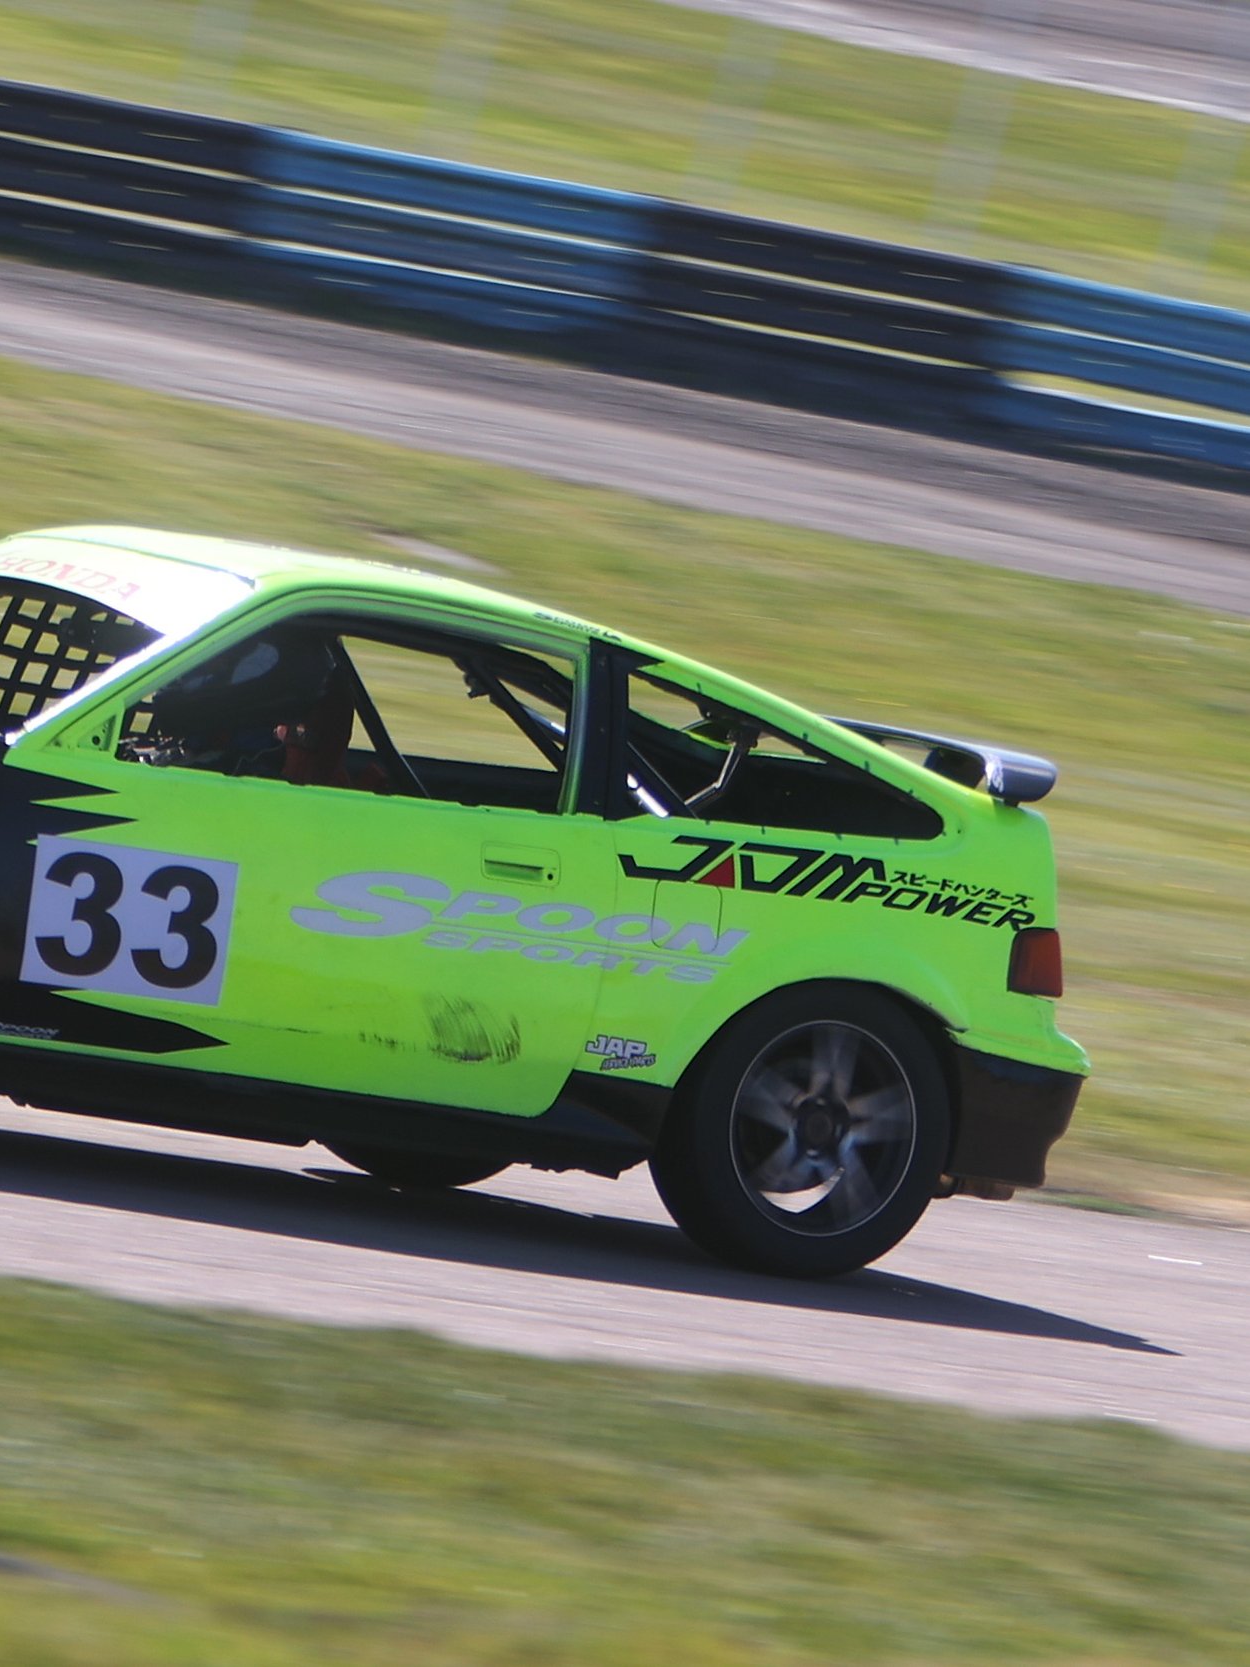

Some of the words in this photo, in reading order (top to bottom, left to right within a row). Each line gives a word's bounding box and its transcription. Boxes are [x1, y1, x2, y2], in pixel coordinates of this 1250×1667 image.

[618, 835, 887, 901] JDM
[890, 870, 1034, 908] スピードハンターズ
[35, 851, 219, 989] 33
[290, 871, 750, 957] SPOON
[842, 882, 1035, 931] POWER
[421, 931, 717, 983] SPORTS
[586, 1034, 646, 1059] JAP
